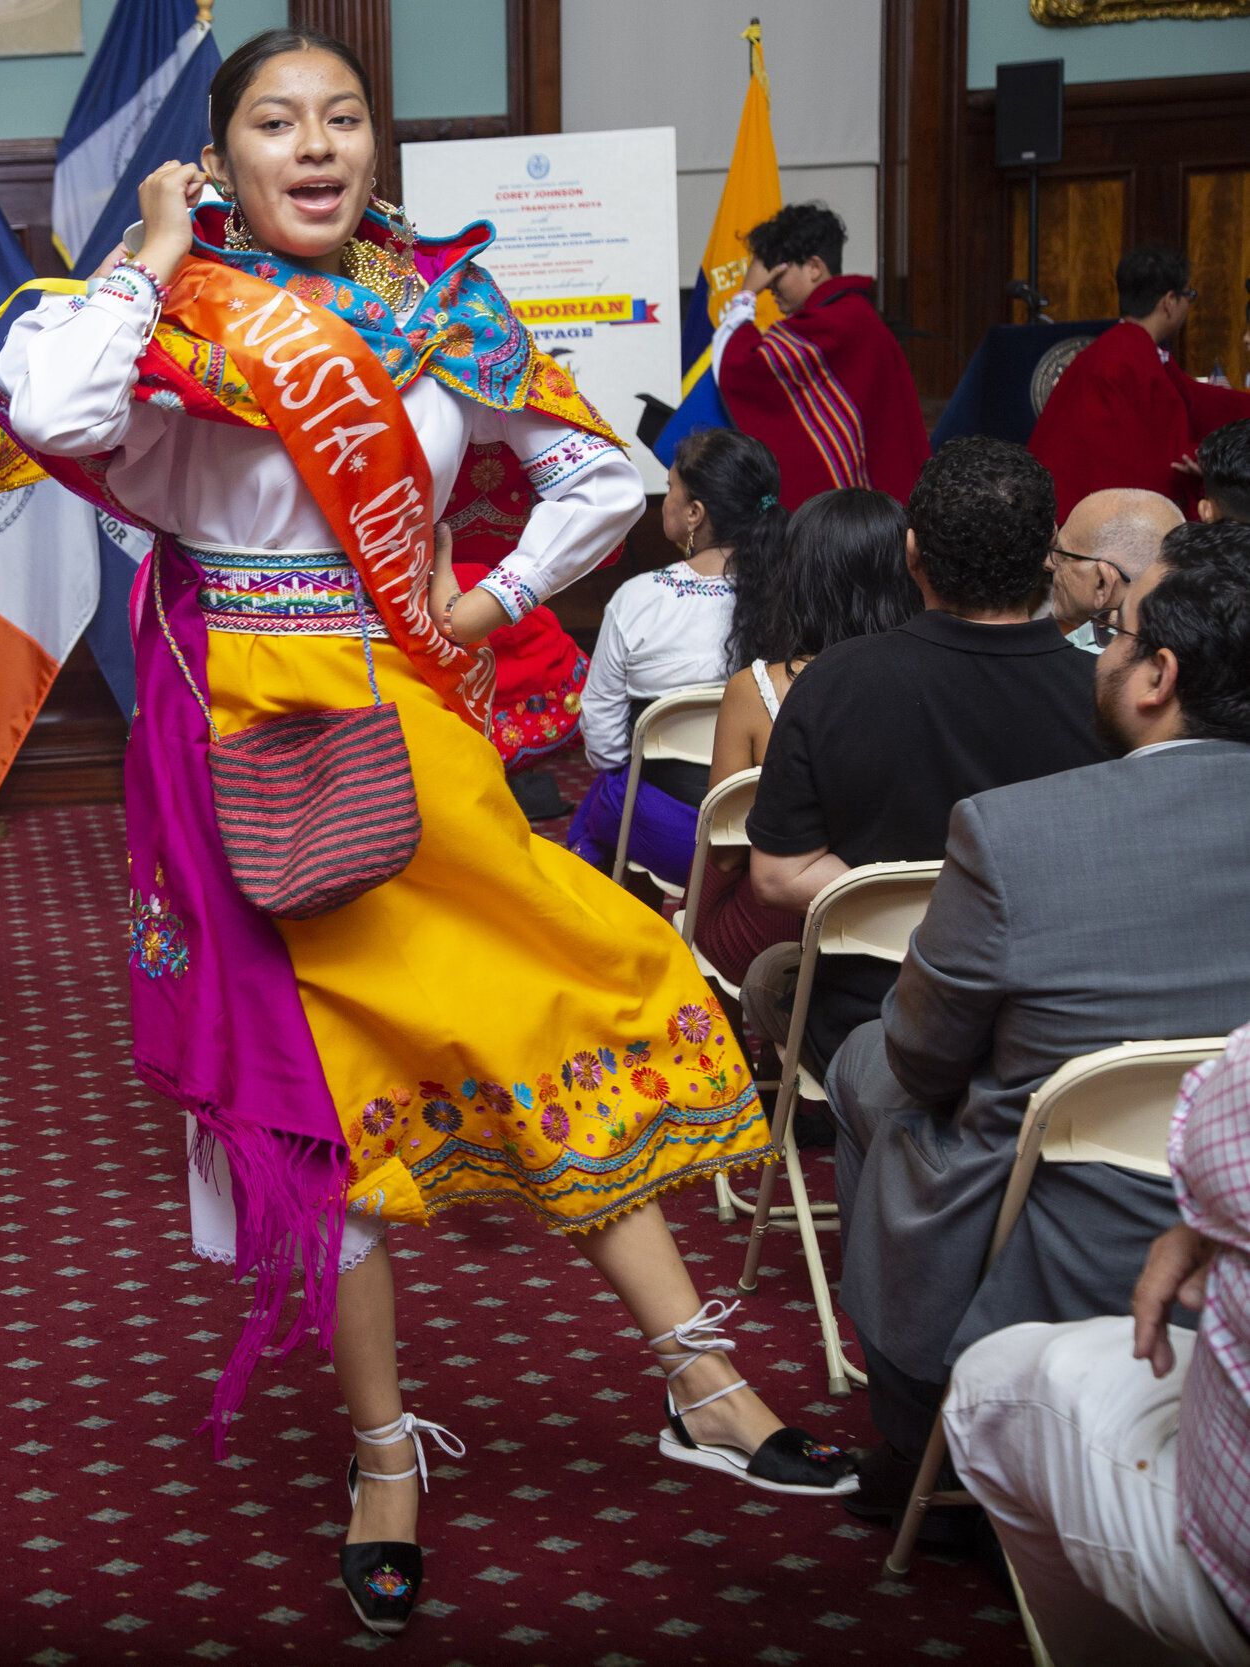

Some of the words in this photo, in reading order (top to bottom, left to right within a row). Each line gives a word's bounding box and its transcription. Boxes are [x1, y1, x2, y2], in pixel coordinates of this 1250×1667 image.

[495, 191, 530, 201] COREY
[534, 188, 583, 199] JOHNSON
[512, 300, 625, 319] ADORIAN
[533, 327, 594, 340] ITAGE
[98, 508, 128, 545] IOR
